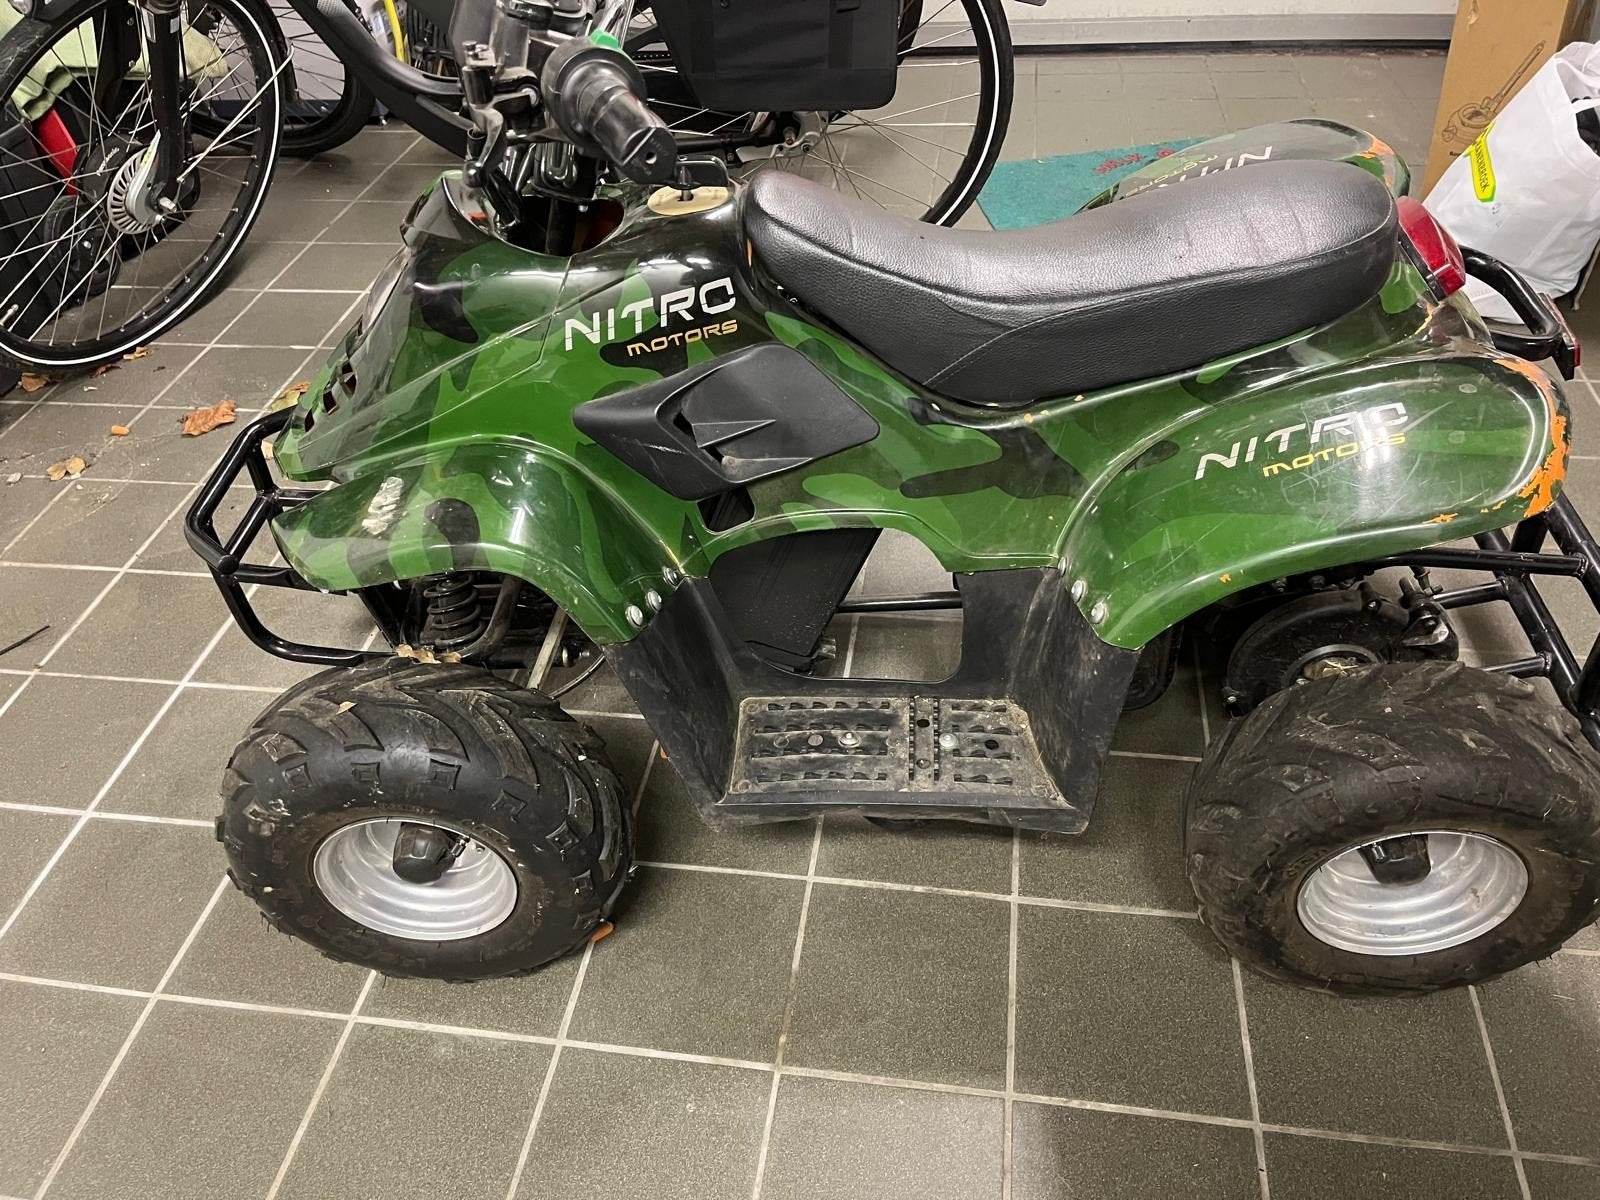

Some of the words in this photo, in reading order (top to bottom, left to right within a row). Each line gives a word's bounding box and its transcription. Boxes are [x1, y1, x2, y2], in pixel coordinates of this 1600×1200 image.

[565, 277, 736, 352] NITRO
[626, 319, 738, 357] MOTORS
[1194, 402, 1409, 481] NITRO
[1262, 432, 1406, 478] MOTORS
